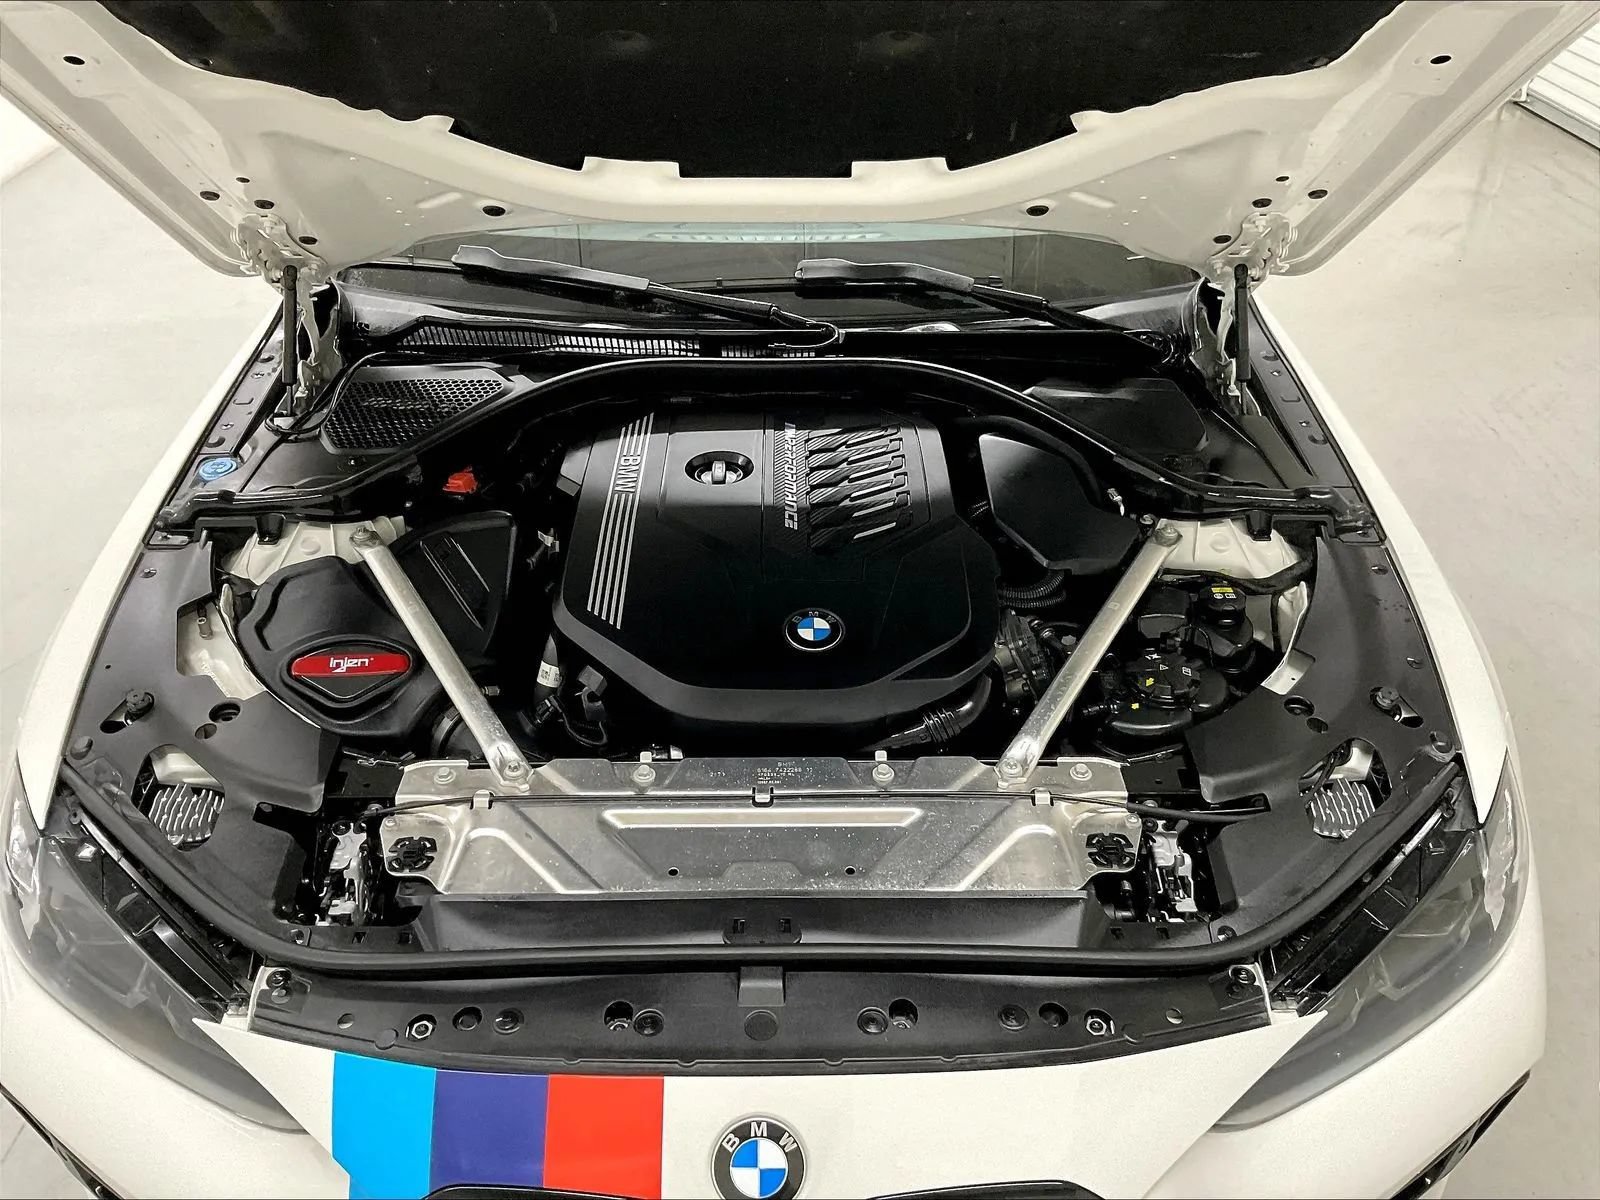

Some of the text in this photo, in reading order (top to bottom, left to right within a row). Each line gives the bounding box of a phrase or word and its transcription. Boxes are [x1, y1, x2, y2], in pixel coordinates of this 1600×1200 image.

[614, 456, 641, 492] BMW
[791, 611, 837, 624] BMW
[721, 1121, 798, 1153] BMW
